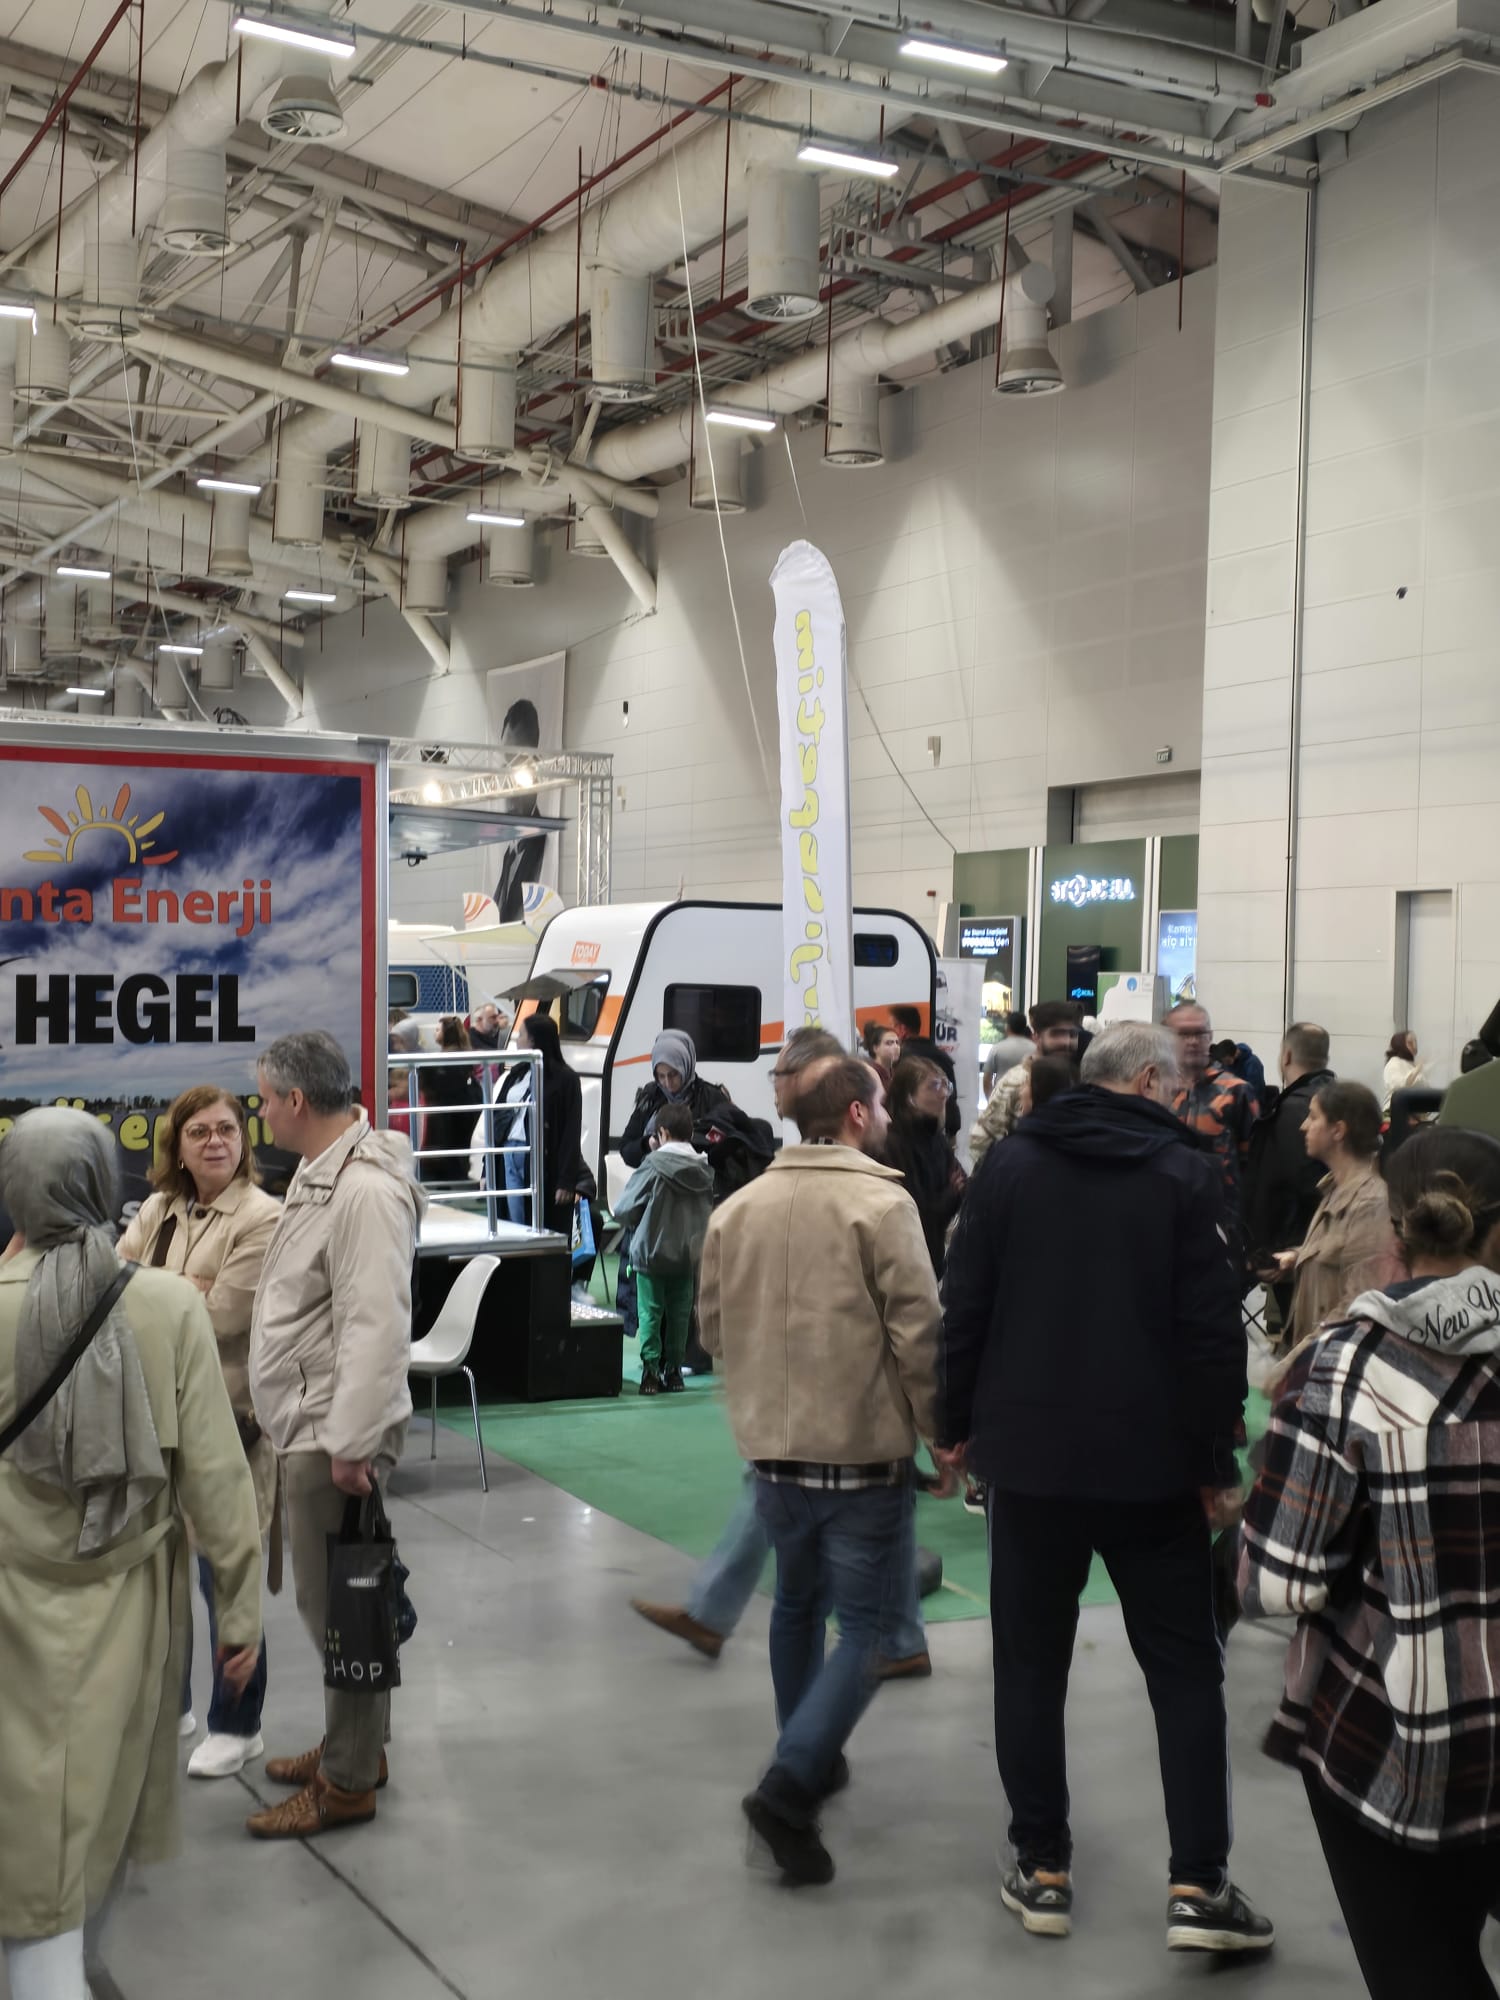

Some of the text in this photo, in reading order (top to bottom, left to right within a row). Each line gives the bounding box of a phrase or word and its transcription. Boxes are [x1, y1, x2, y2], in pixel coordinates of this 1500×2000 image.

[113, 878, 272, 937] Enerji
[15, 973, 256, 1045] HEGEL
[1407, 1304, 1469, 1345] New
[323, 1658, 383, 1682] HOP
